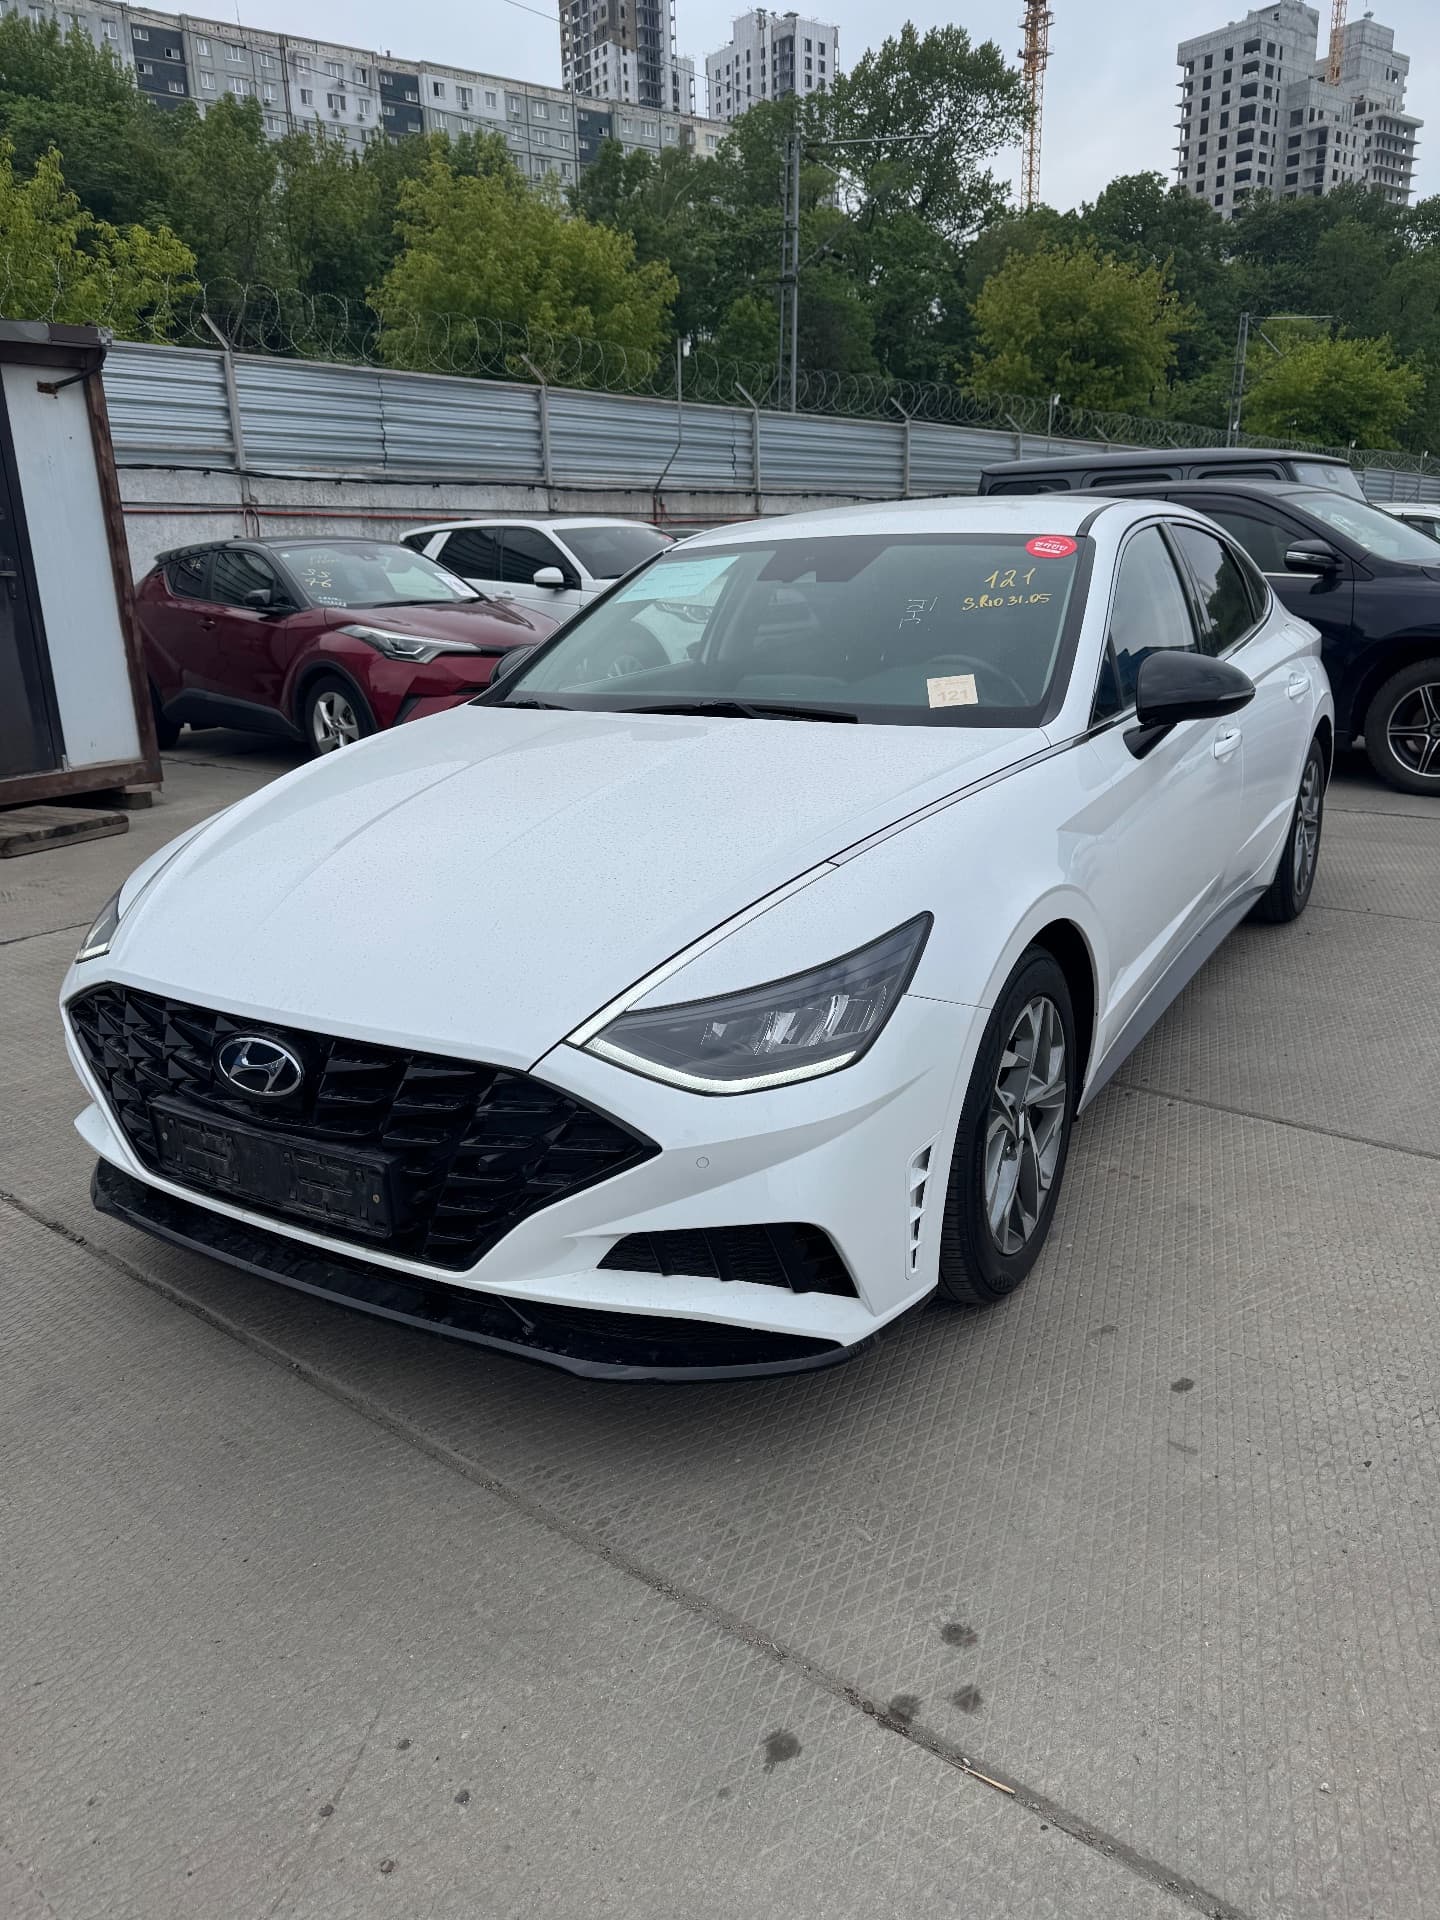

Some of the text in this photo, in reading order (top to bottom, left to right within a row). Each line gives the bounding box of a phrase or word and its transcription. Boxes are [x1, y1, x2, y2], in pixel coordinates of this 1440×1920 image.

[983, 567, 1037, 589] 121
[1007, 593, 1053, 606] 31.05
[937, 689, 969, 702] 121
